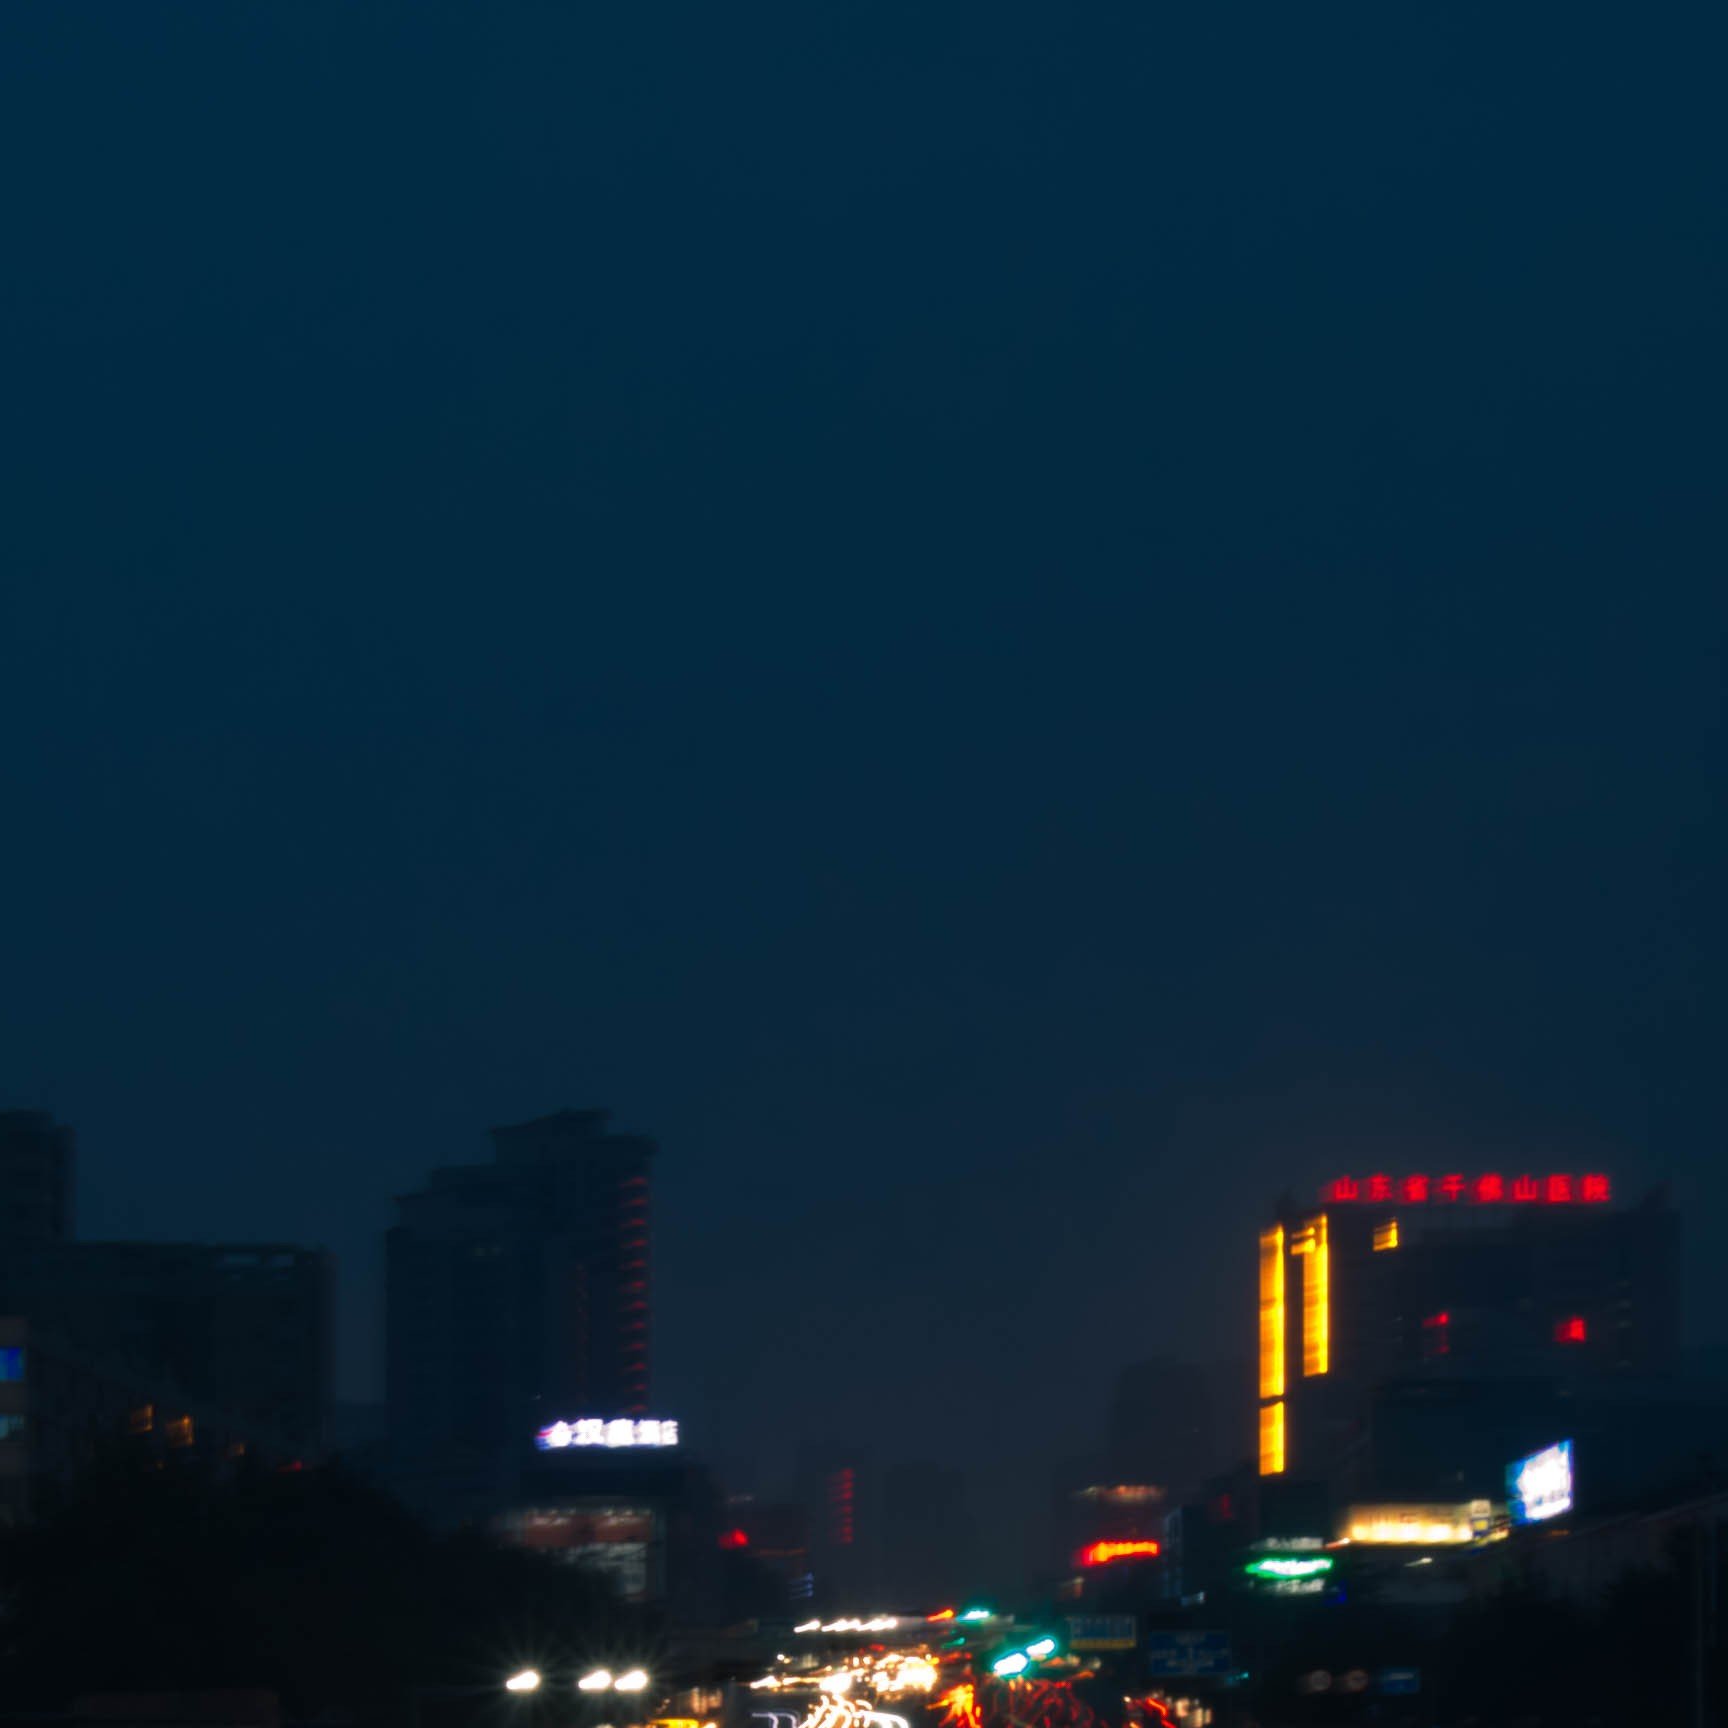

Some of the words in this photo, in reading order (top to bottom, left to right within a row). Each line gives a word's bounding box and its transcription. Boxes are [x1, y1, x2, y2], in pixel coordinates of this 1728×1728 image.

[1332, 1173, 1610, 1202] 山东省千佛山医院
